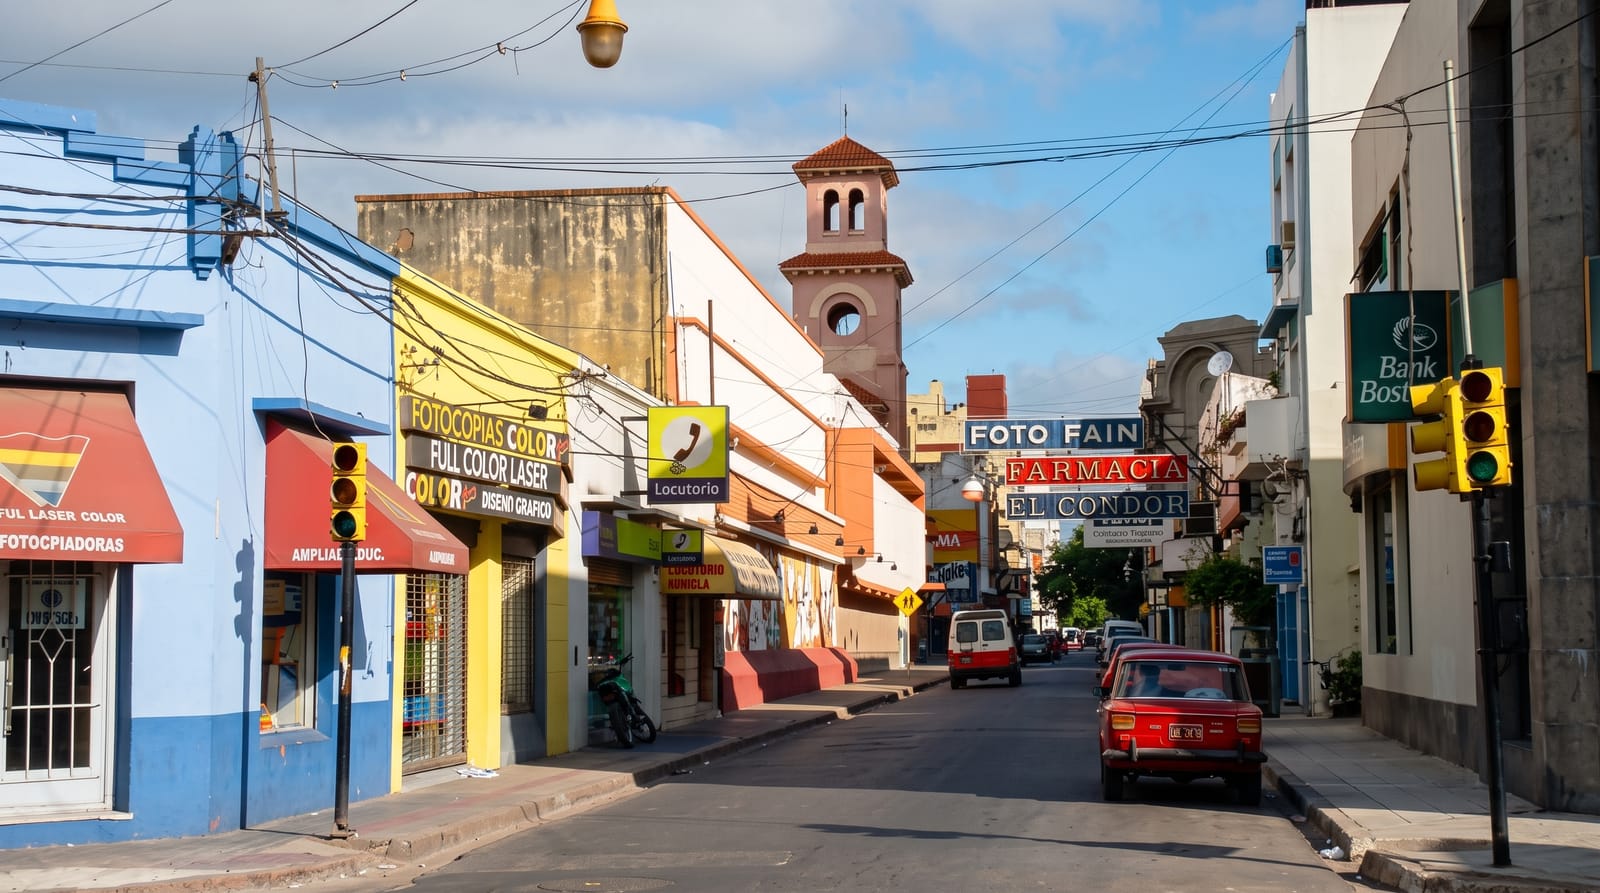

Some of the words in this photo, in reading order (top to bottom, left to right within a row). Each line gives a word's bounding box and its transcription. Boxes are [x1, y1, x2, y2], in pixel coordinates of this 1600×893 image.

[1379, 355, 1438, 379] Bank
[412, 398, 504, 447] FOTOCOPIAS
[507, 424, 557, 459] COLOR
[970, 424, 1048, 445] FOTO
[1064, 423, 1138, 444] FAIN
[430, 439, 461, 474] FULL
[463, 447, 507, 483] COLOR
[510, 457, 548, 490] LASER
[1007, 459, 1185, 482] FARMACIA
[405, 472, 462, 510] COLOR
[515, 496, 552, 520] GRAFICO
[655, 481, 720, 496] Locutorio
[29, 509, 77, 522] LASER
[80, 511, 127, 524] COLOR
[1009, 496, 1045, 517] EL
[1058, 495, 1188, 517] CONDOR
[0, 534, 125, 553] FOTOCPIADORAS
